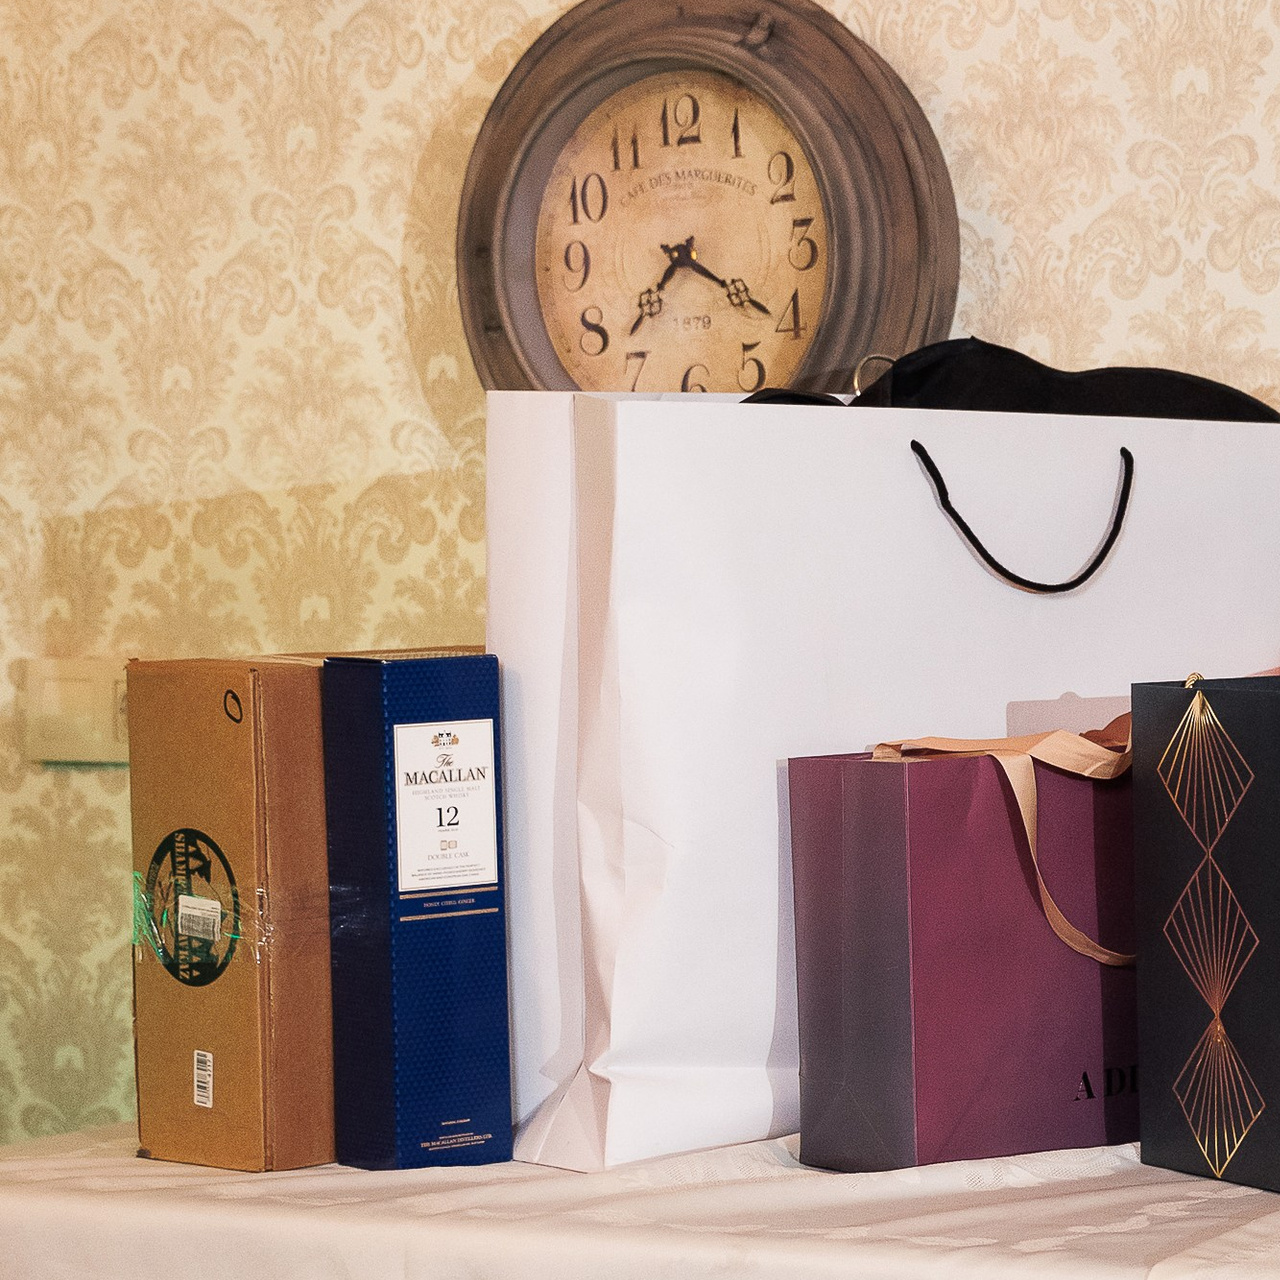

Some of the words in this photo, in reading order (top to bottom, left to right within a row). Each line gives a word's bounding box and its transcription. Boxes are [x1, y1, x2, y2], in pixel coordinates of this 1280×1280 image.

[660, 93, 701, 147] 12
[731, 107, 745, 159] 1
[610, 123, 643, 172] 11
[569, 172, 609, 226] 10
[767, 151, 796, 205] 2
[563, 239, 591, 293] 9
[788, 218, 818, 271] 3
[580, 306, 609, 357] 8
[775, 287, 807, 341] 4
[625, 350, 651, 392] 7
[737, 341, 766, 393] 5
[404, 766, 488, 787] MACALLAN
[434, 753, 454, 769] The
[436, 806, 460, 827] 12
